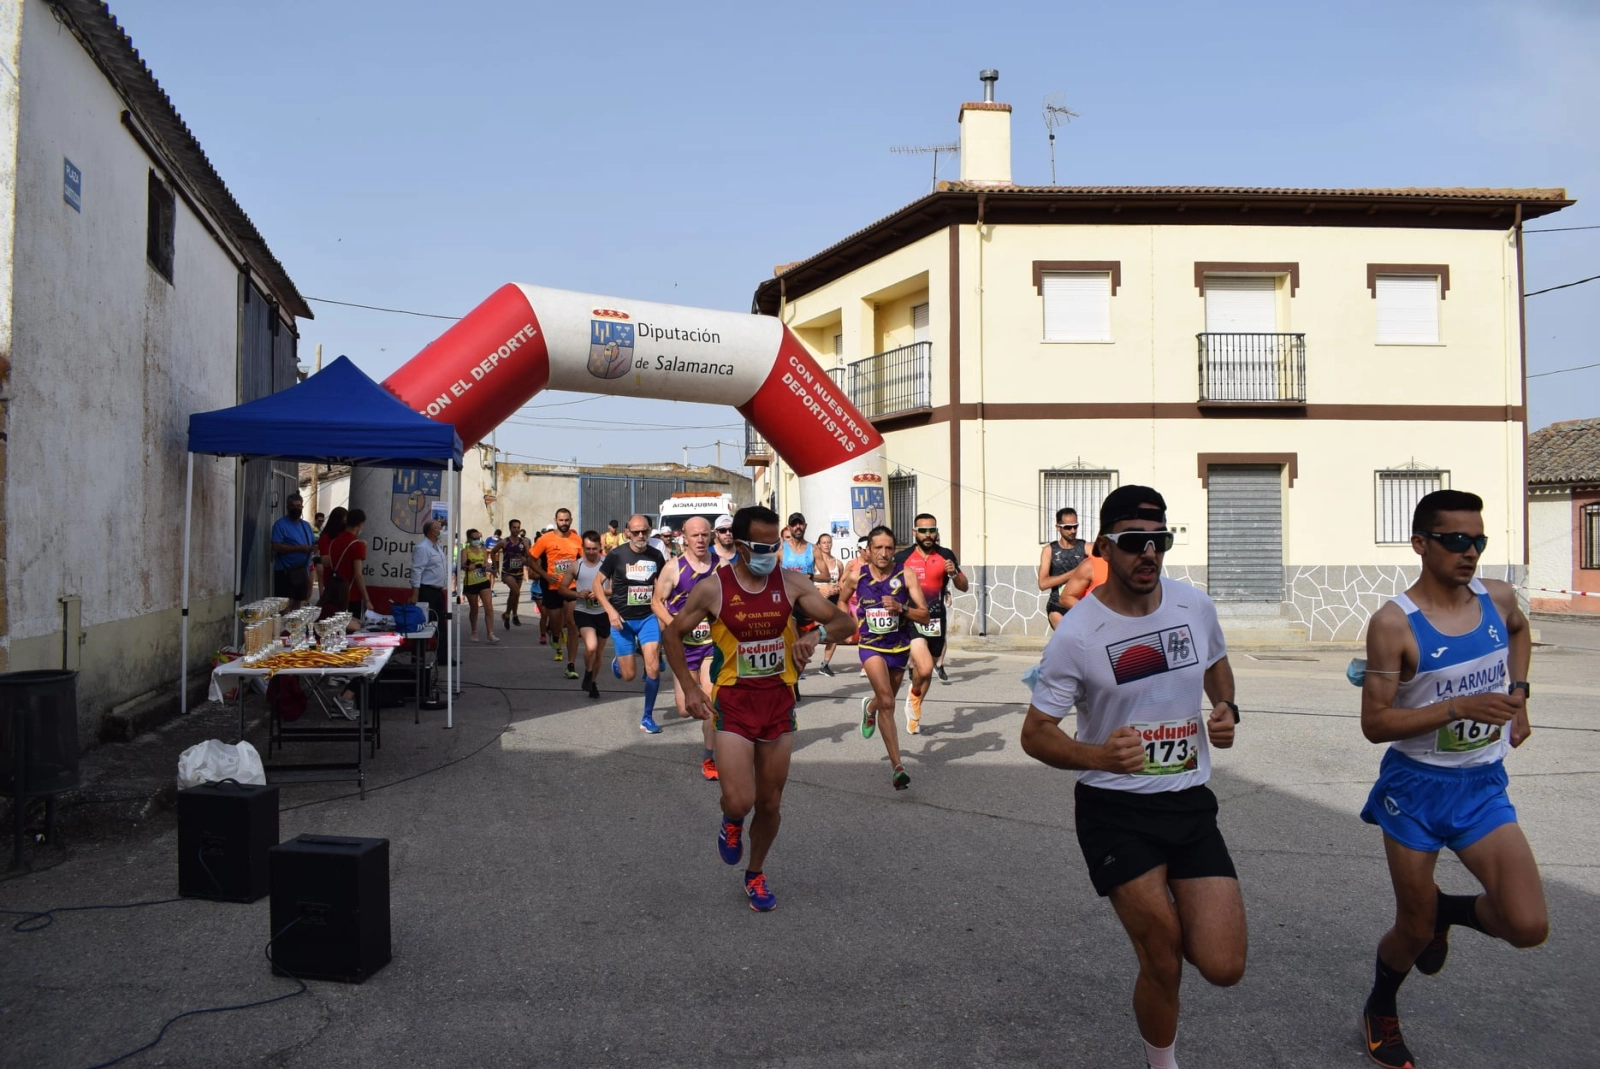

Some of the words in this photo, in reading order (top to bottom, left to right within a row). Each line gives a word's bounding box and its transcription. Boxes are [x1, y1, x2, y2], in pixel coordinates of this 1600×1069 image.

[638, 322, 720, 343] Diputación
[420, 393, 452, 419] ON
[450, 379, 473, 398] EL
[470, 323, 537, 381] DEPORTE
[635, 357, 649, 369] de
[655, 355, 734, 376] Salamanca
[789, 356, 814, 384] CON
[813, 382, 869, 445] NUESTROS
[781, 372, 855, 452] DEPORTISTAS
[748, 621, 771, 630] VINO
[872, 617, 893, 628] 103
[737, 641, 785, 655] bedunia
[749, 652, 777, 669] 110
[1436, 679, 1453, 697] LA
[1145, 739, 1188, 763] 173
